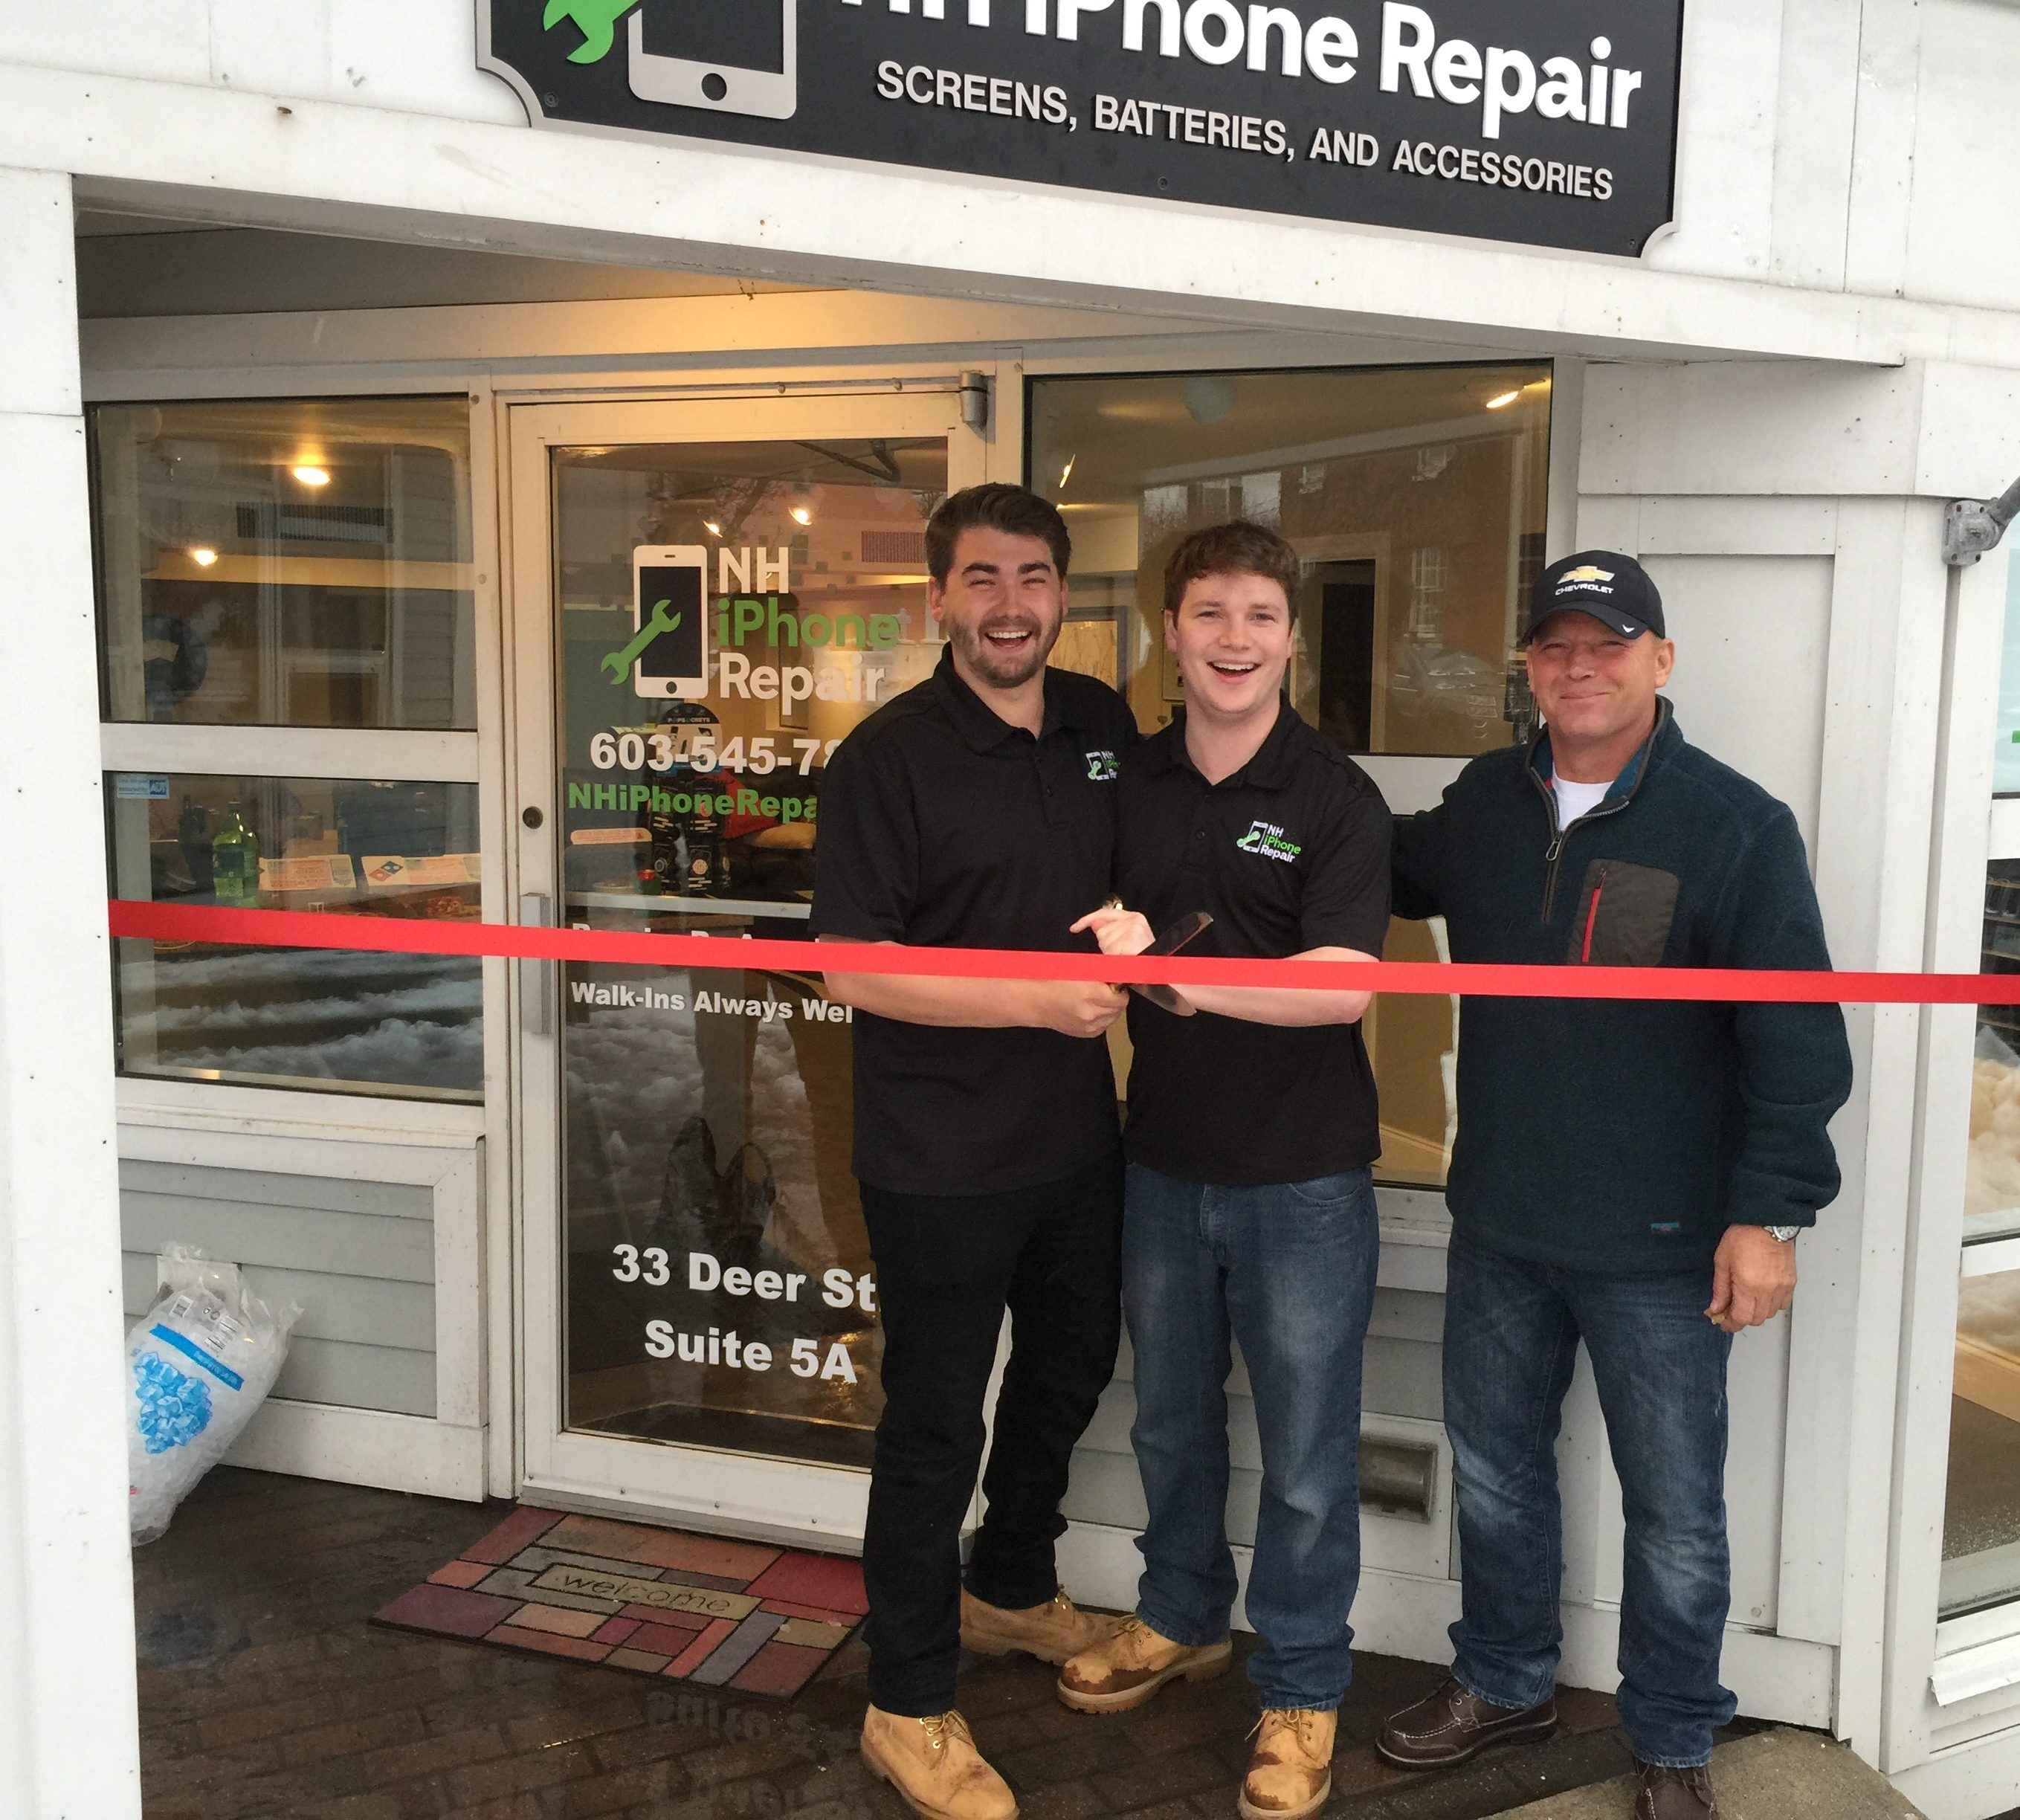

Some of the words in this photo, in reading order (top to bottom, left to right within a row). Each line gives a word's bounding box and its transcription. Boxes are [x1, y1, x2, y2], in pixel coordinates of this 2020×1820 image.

[1379, 1, 1642, 140] Repair
[877, 60, 1077, 132] SCREENS,
[1095, 94, 1294, 163] BATTERIES,
[1309, 127, 1379, 167] AND
[1393, 139, 1613, 200] ACCESSORIES
[718, 546, 789, 594] NH
[1555, 583, 1614, 596] CHEVROLET
[717, 597, 900, 648] iPhone
[719, 652, 885, 716] Repair
[1259, 844, 1295, 863] Repair
[1263, 834, 1302, 854] iPhone
[1267, 825, 1284, 838] NH
[572, 981, 685, 1011] Walk-Ins
[693, 991, 793, 1023] Always
[613, 1244, 671, 1285] 33
[689, 1252, 807, 1302] Deer
[645, 1320, 772, 1371] Suite
[790, 1337, 858, 1384] 5A
[564, 1575, 731, 1612] welcome
